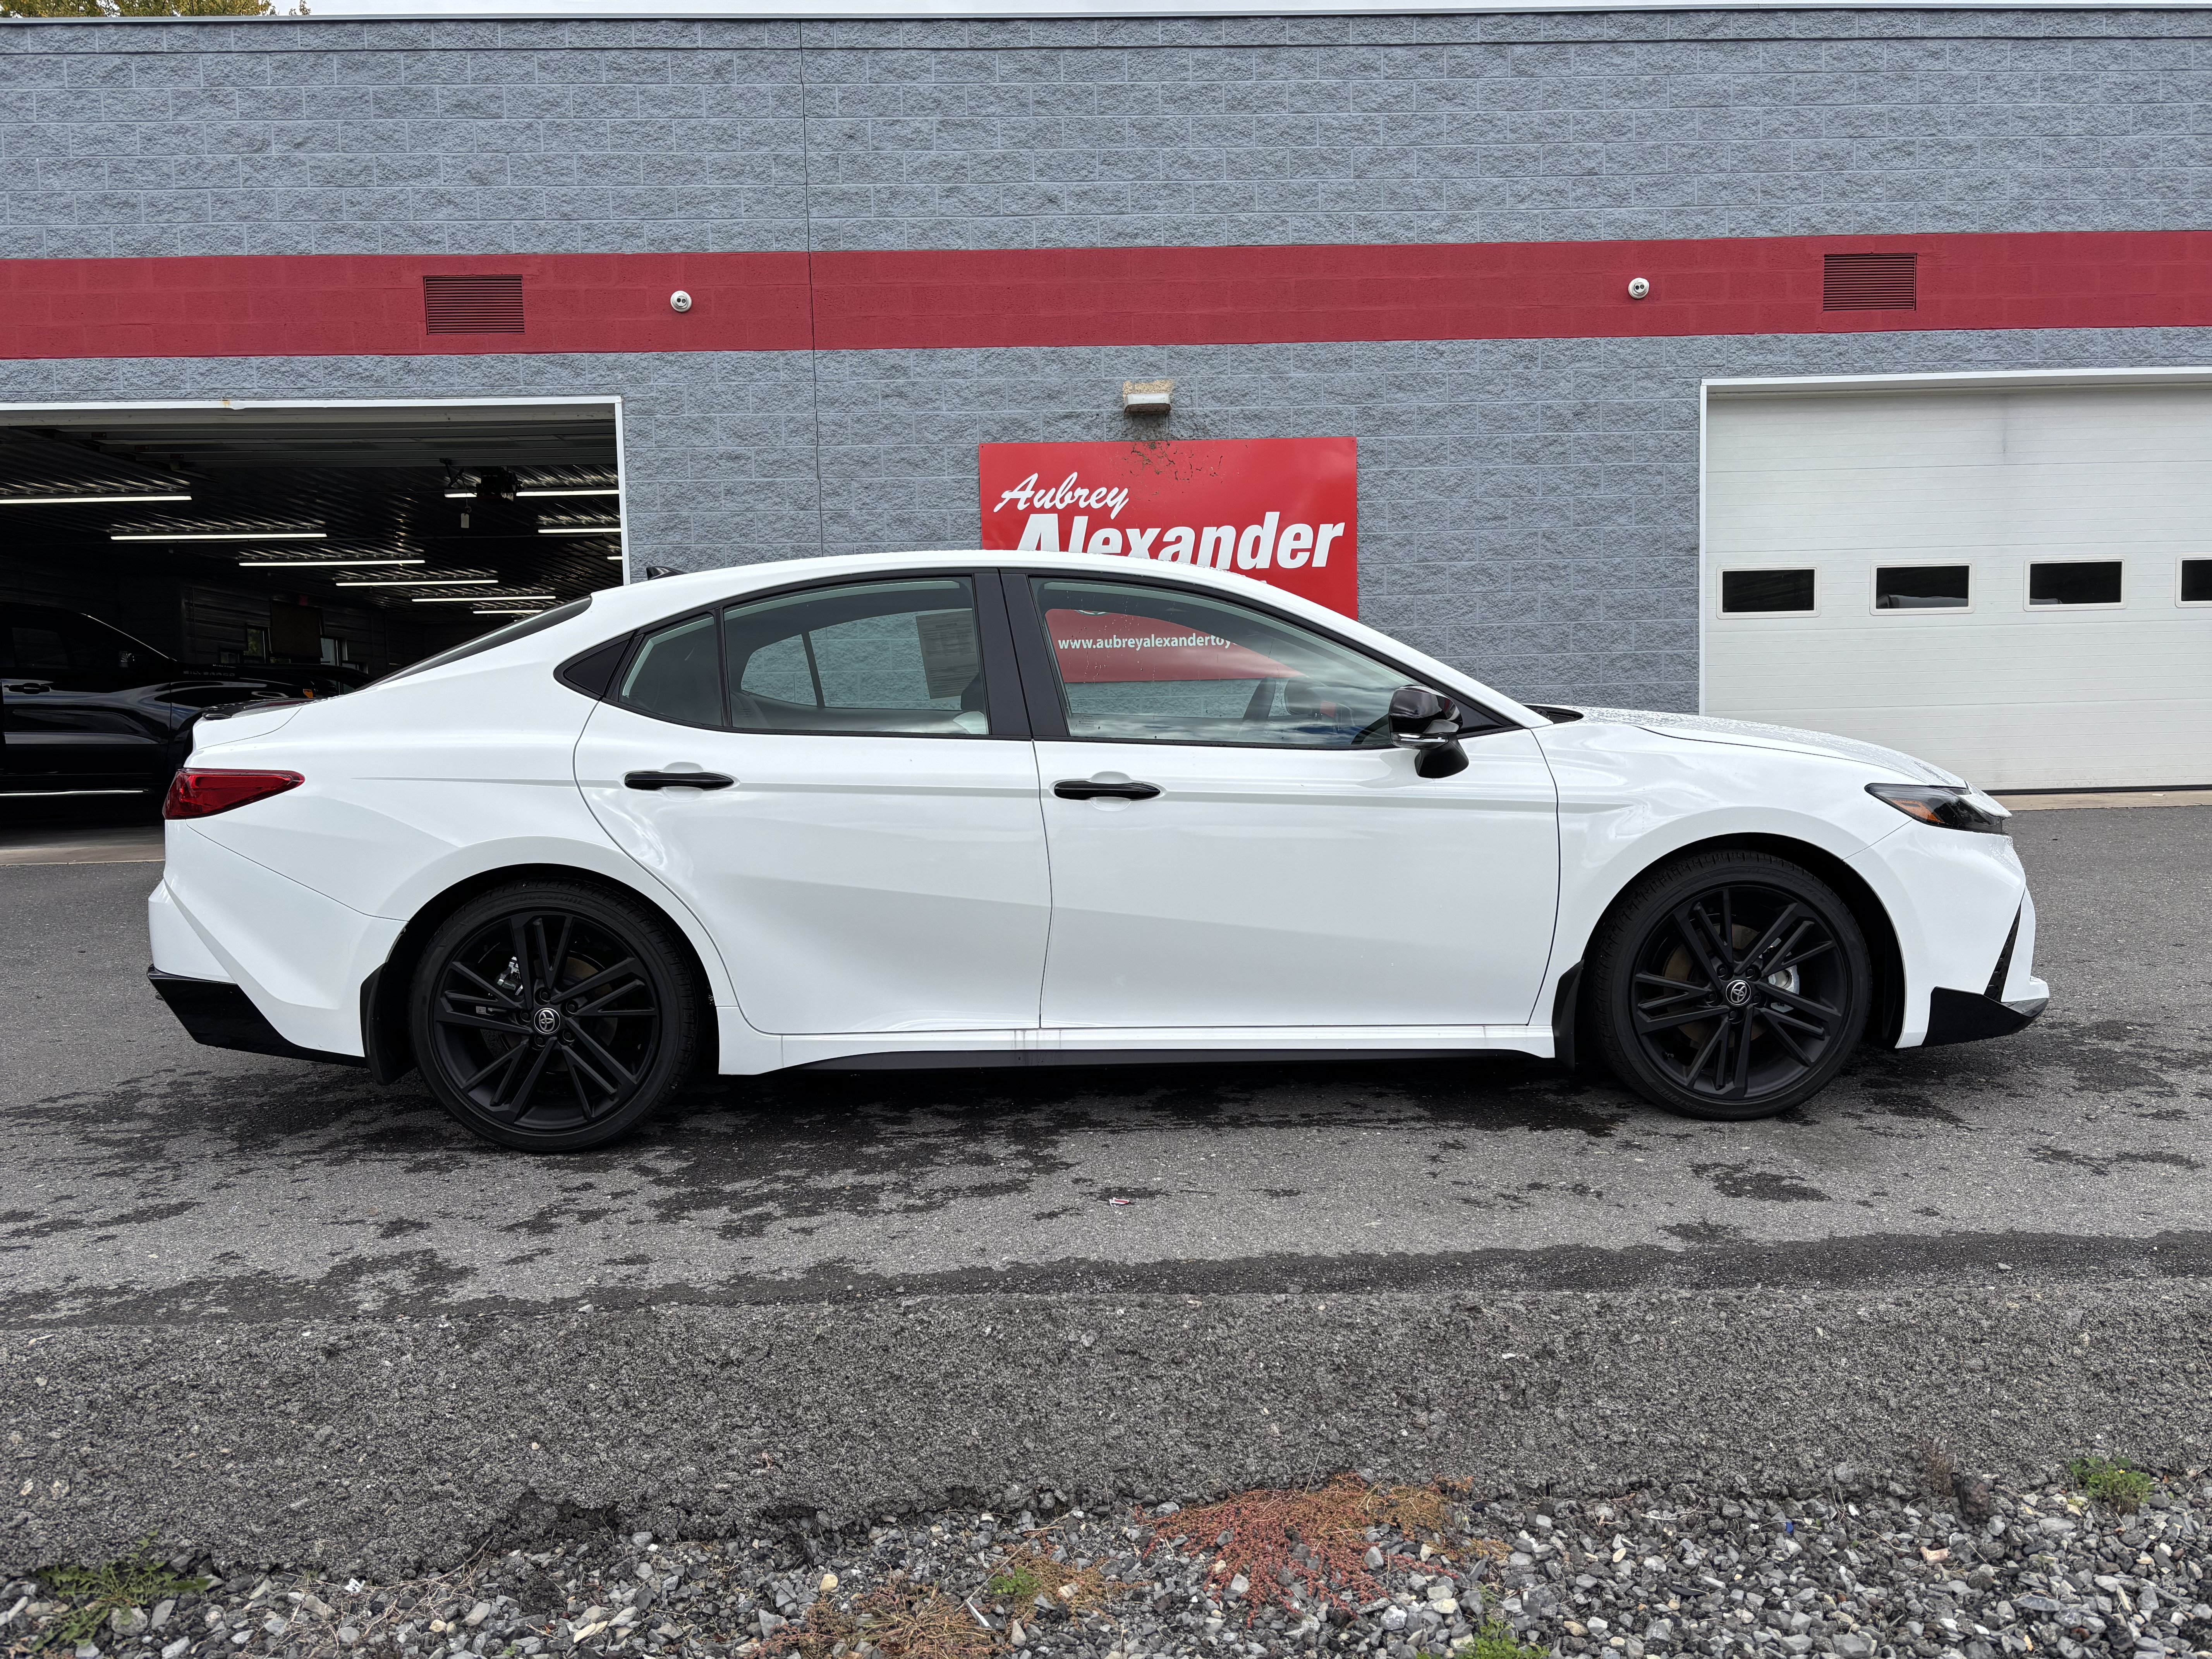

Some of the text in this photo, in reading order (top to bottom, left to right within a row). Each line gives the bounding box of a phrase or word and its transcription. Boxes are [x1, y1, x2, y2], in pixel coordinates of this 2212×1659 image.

[993, 471, 1129, 520] Aubrey
[1017, 511, 1346, 570] Alexander
[1058, 632, 1238, 651] www.aubreyalexandertoy
